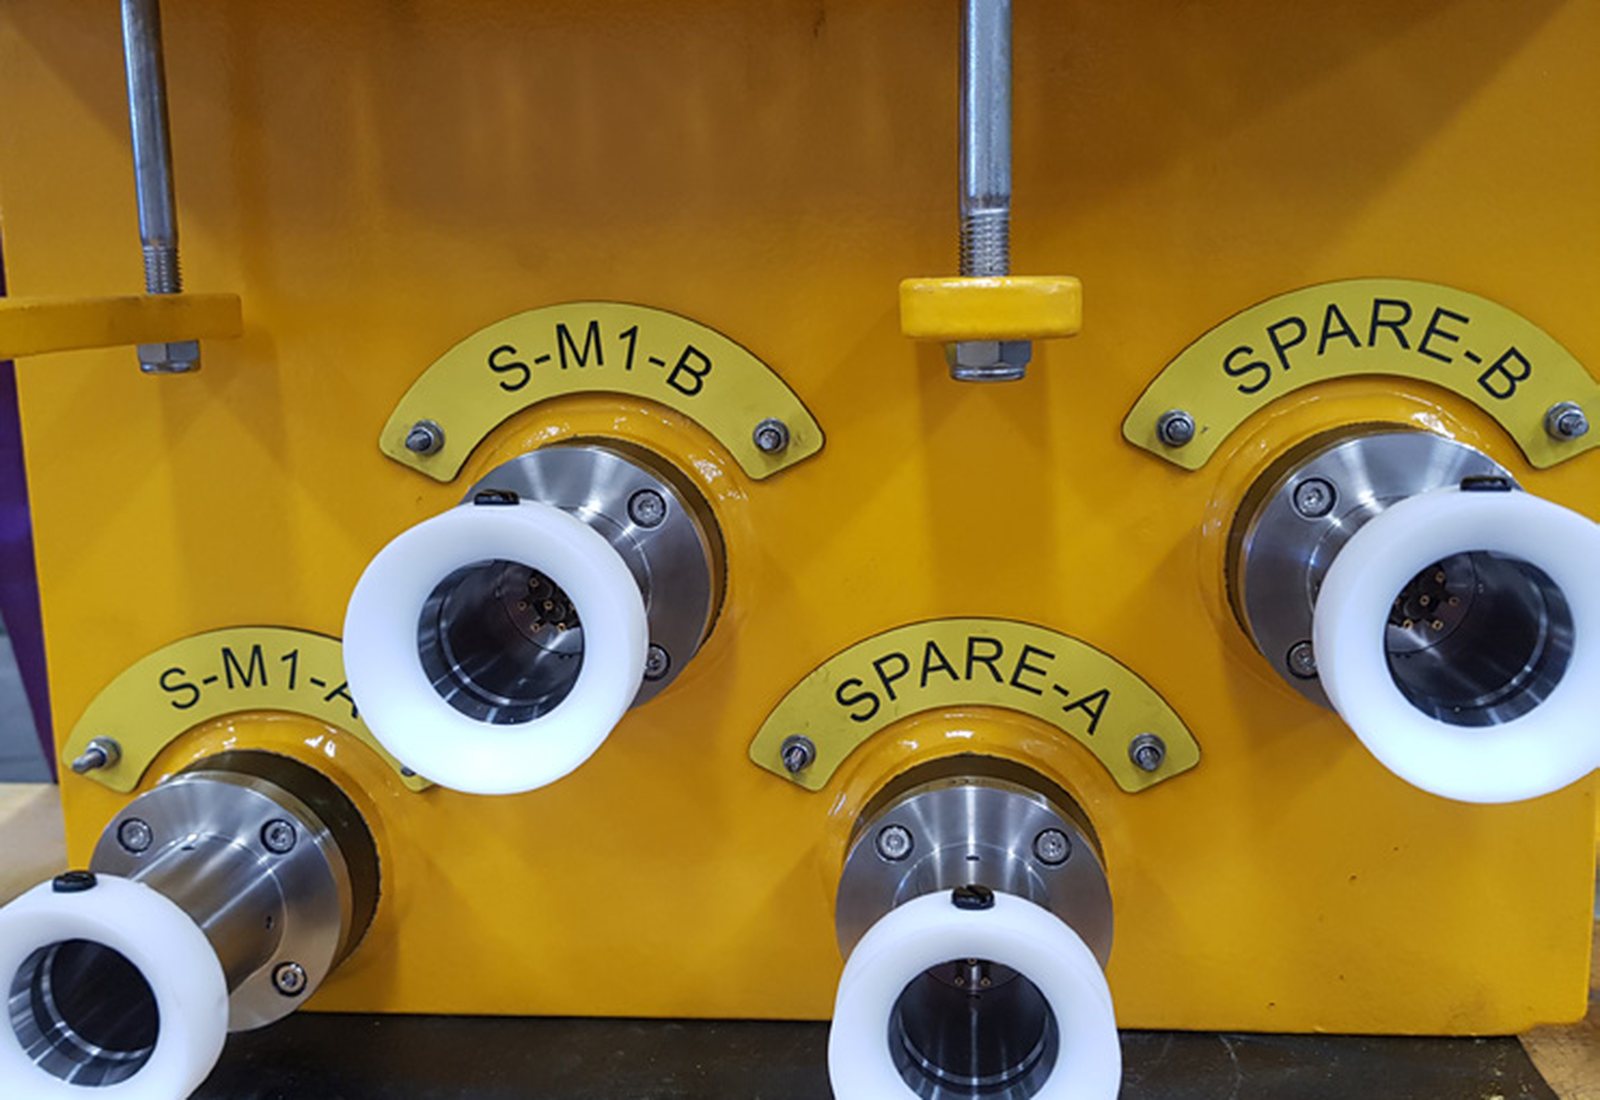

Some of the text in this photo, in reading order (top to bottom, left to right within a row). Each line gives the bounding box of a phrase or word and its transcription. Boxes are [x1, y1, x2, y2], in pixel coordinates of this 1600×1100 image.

[487, 320, 713, 397] S-M1-B
[1223, 298, 1532, 400] SPARE-B
[835, 636, 1112, 736] SPARE-A
